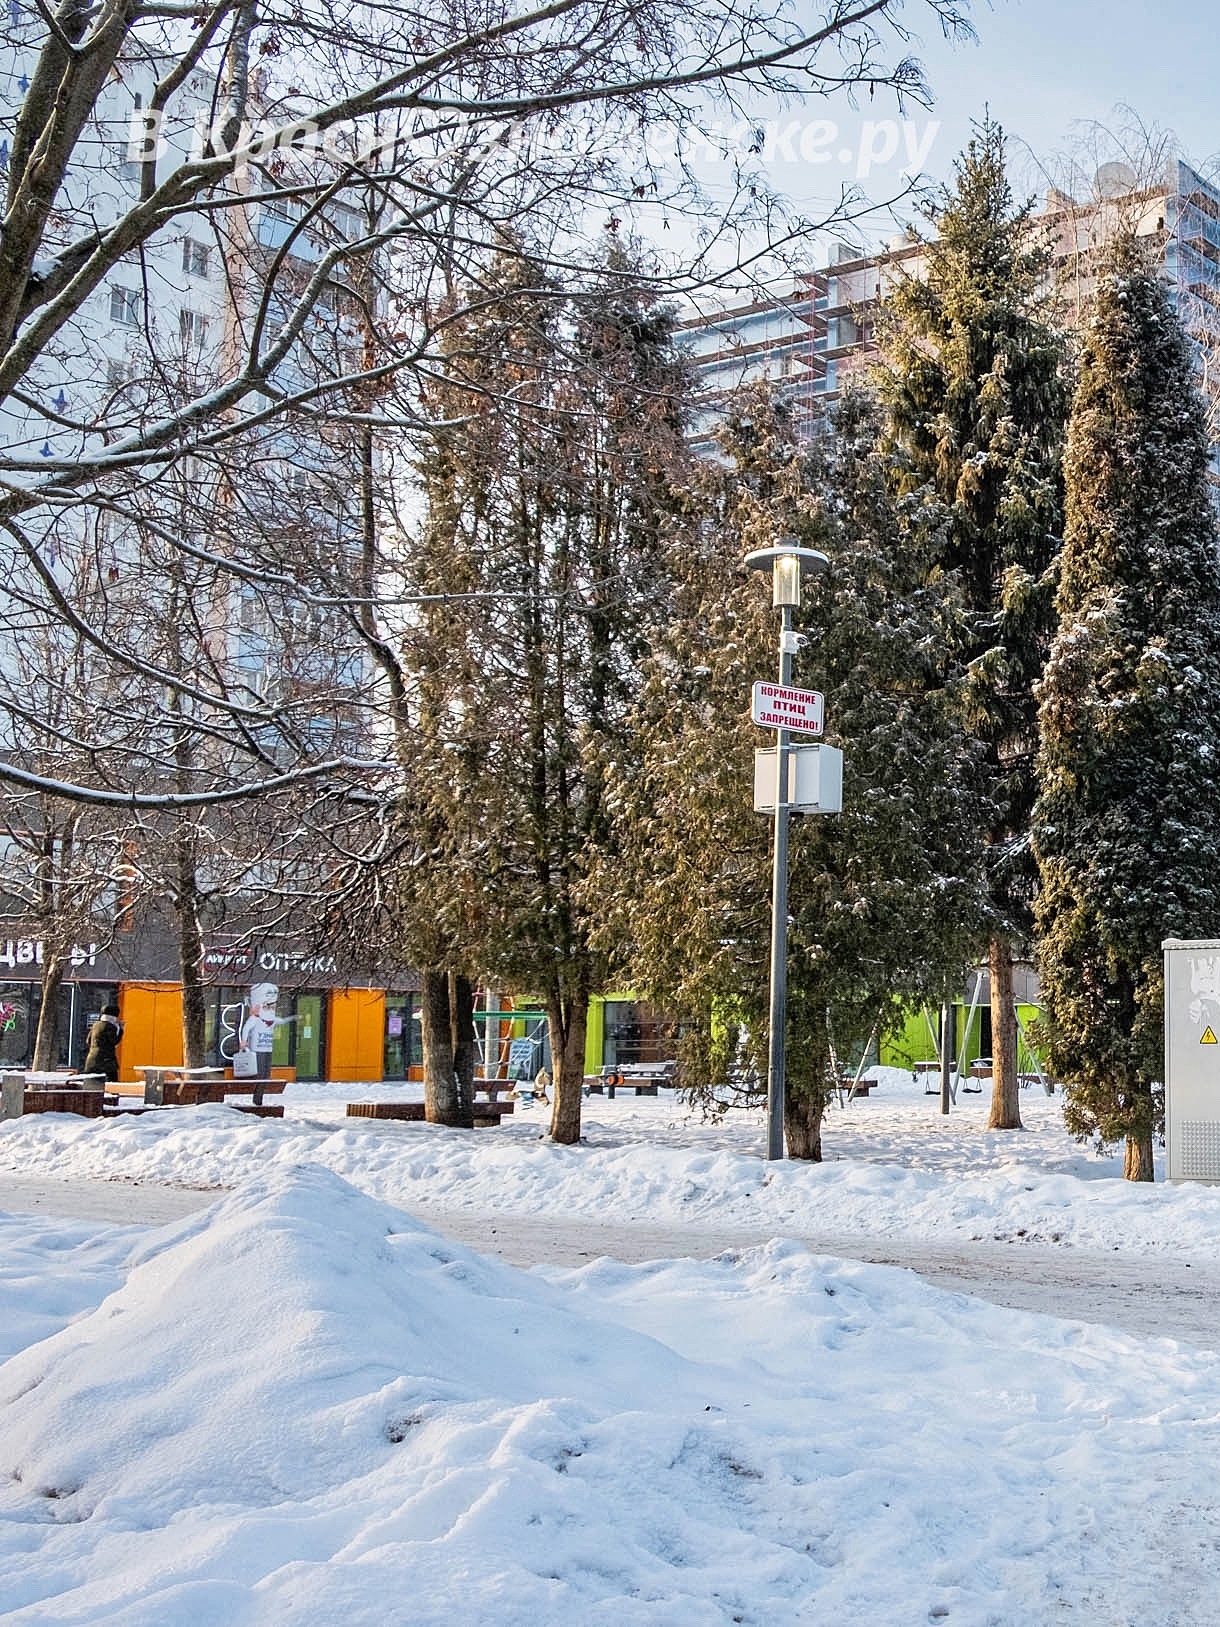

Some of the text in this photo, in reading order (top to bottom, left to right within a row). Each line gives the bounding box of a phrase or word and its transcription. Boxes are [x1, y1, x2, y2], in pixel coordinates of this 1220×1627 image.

[761, 687, 815, 704] КОРМЛЕНИЕ
[774, 701, 806, 715] ПТИЦ
[761, 712, 818, 730] ЗАПРЕЩЕНО!
[0, 939, 97, 968] ЦВЫ
